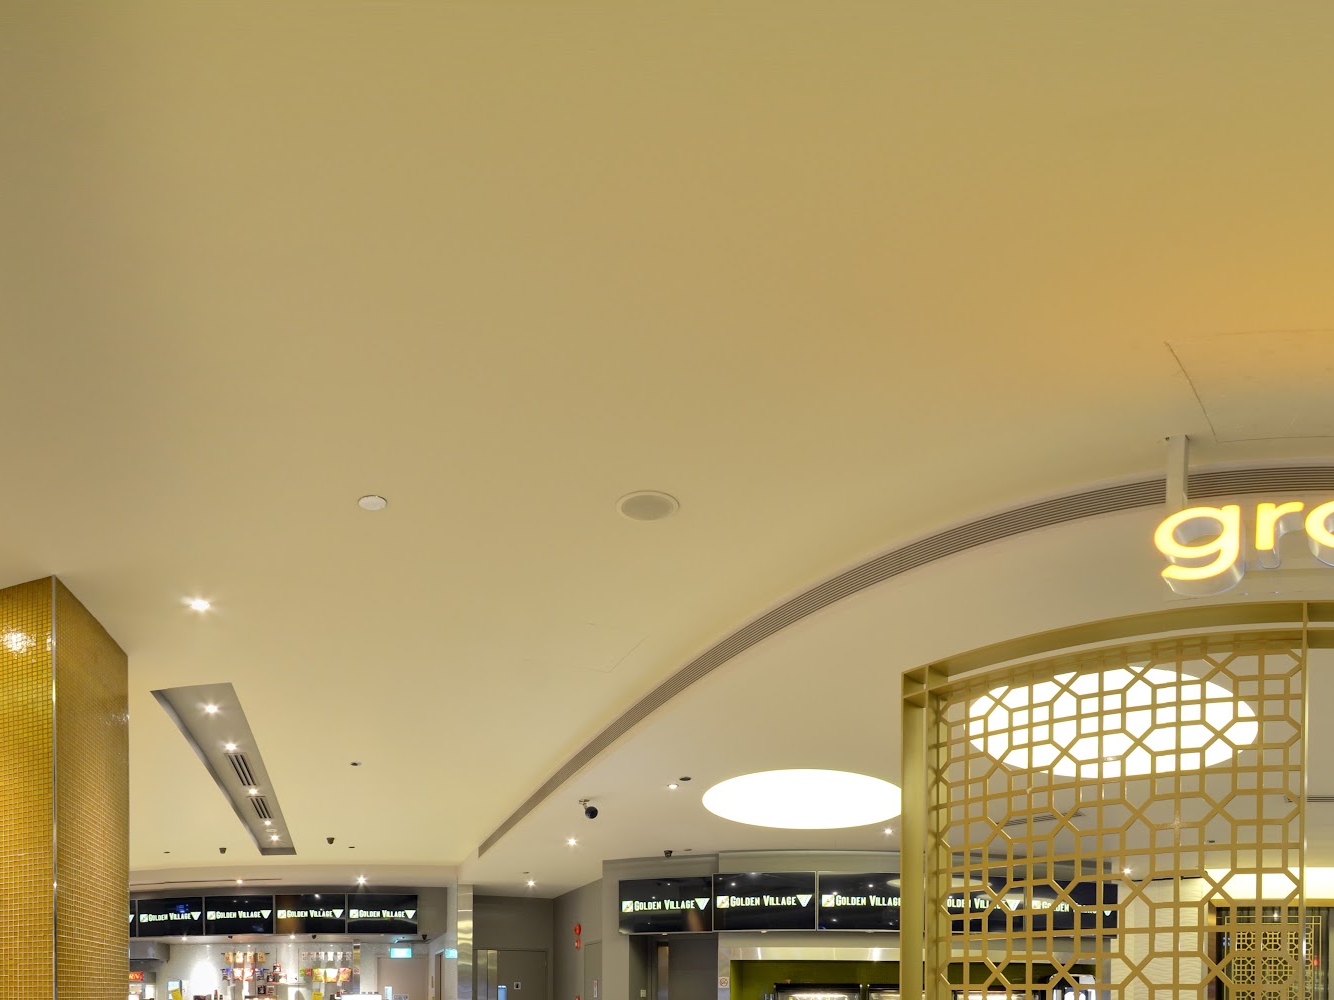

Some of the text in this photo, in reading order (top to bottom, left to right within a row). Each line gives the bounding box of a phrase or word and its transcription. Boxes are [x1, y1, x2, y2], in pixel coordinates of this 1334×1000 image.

[634, 900, 695, 912] GOLDEN VILLAGE
[730, 895, 797, 907] GOLDEN VILLAGE
[836, 894, 866, 906] GOLDEN
[309, 910, 333, 918] VILLAGE
[382, 910, 405, 918] VILLAGE
